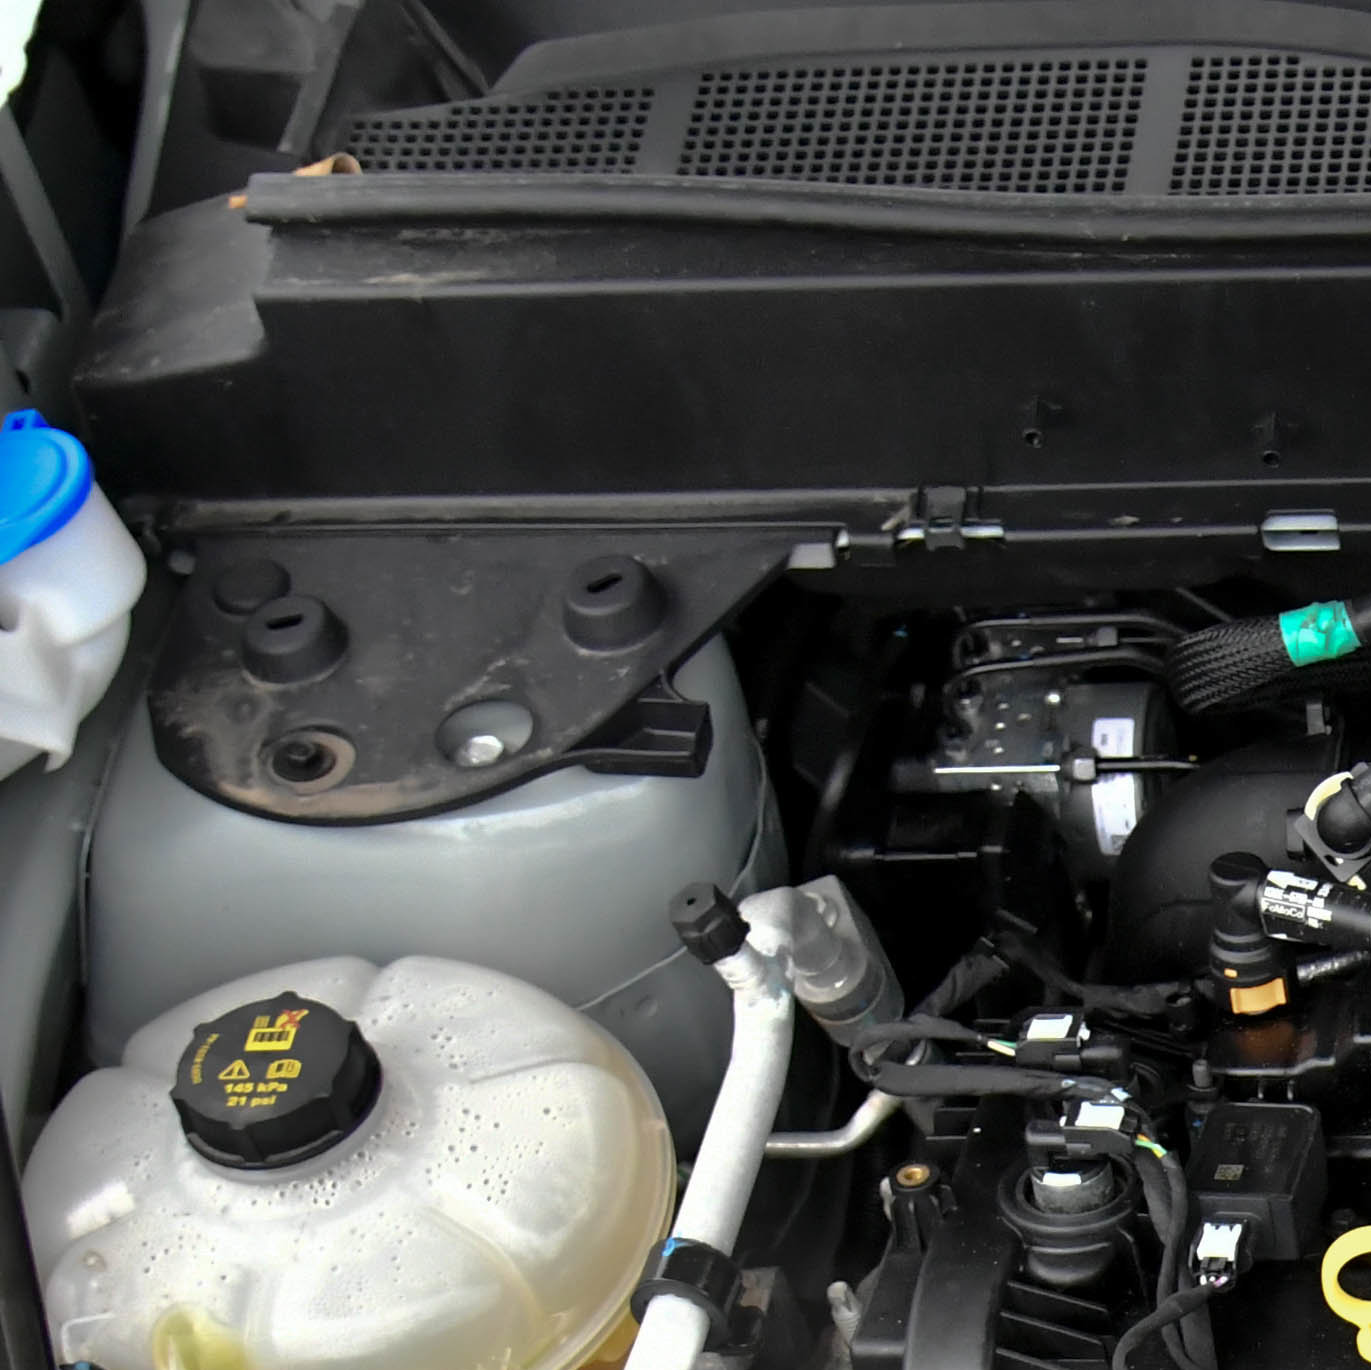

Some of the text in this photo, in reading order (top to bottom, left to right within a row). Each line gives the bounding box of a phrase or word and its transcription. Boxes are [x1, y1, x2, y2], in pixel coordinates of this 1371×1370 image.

[256, 1083, 288, 1094] kPa
[226, 1095, 277, 1108] 21 psi
